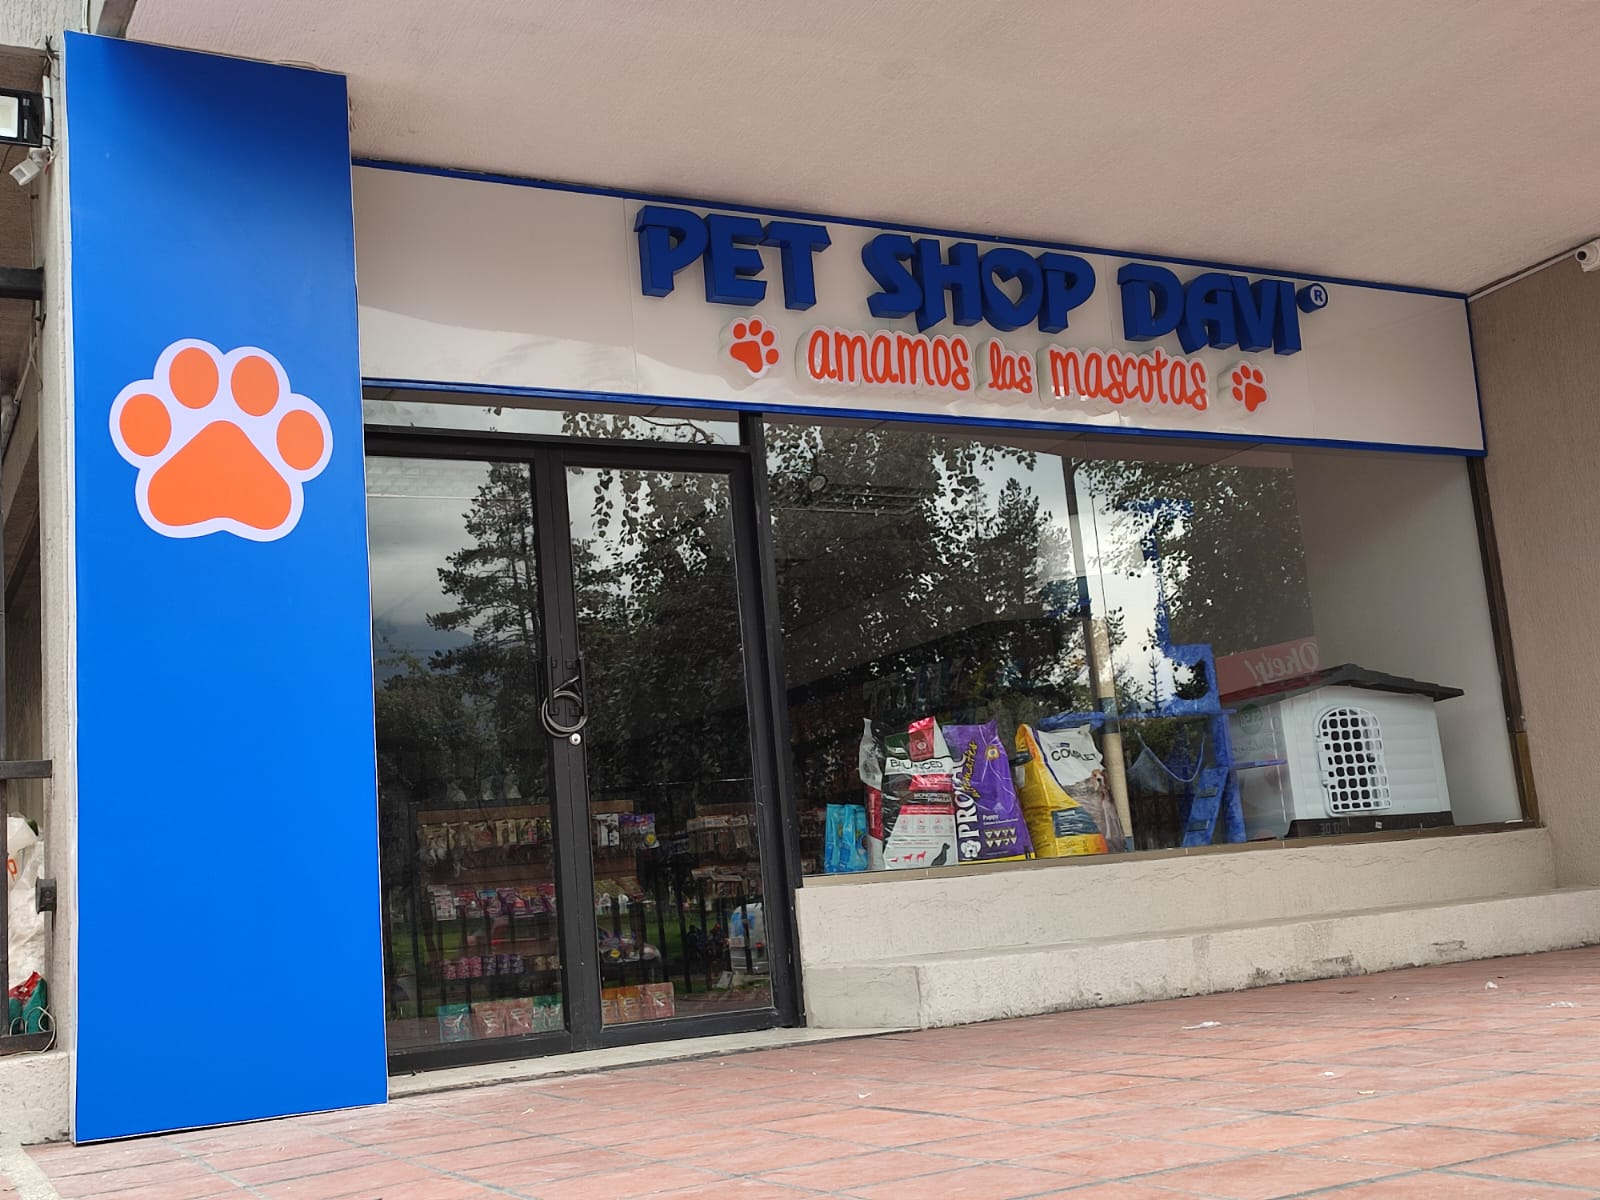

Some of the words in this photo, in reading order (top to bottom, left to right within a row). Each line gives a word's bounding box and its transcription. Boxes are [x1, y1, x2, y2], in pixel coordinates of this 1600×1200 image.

[634, 204, 832, 311] PET
[862, 233, 1096, 334] SHOP
[808, 330, 970, 391] amamos
[988, 341, 1033, 394] las
[1050, 350, 1208, 411] mascotas
